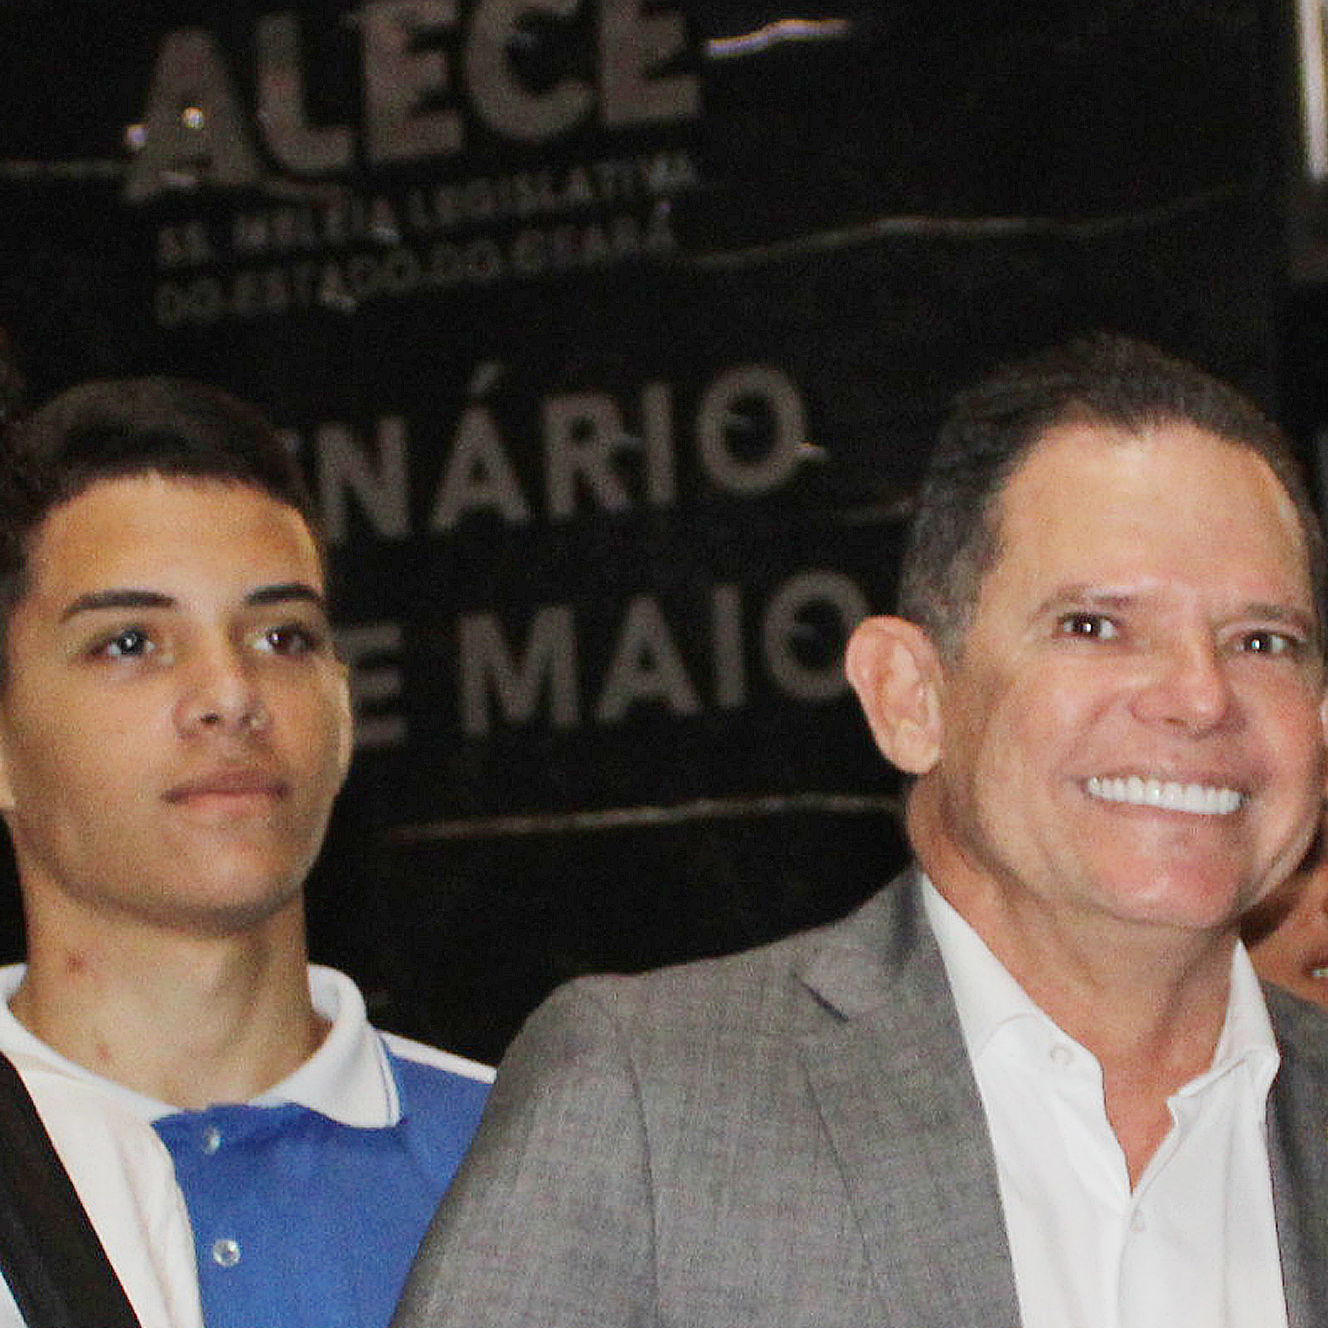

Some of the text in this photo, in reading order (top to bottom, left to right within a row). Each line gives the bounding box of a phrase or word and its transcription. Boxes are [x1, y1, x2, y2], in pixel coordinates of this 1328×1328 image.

[122, 0, 702, 201] ALECE
[288, 362, 808, 544] NÁRIO
[458, 570, 874, 736] MAIO
